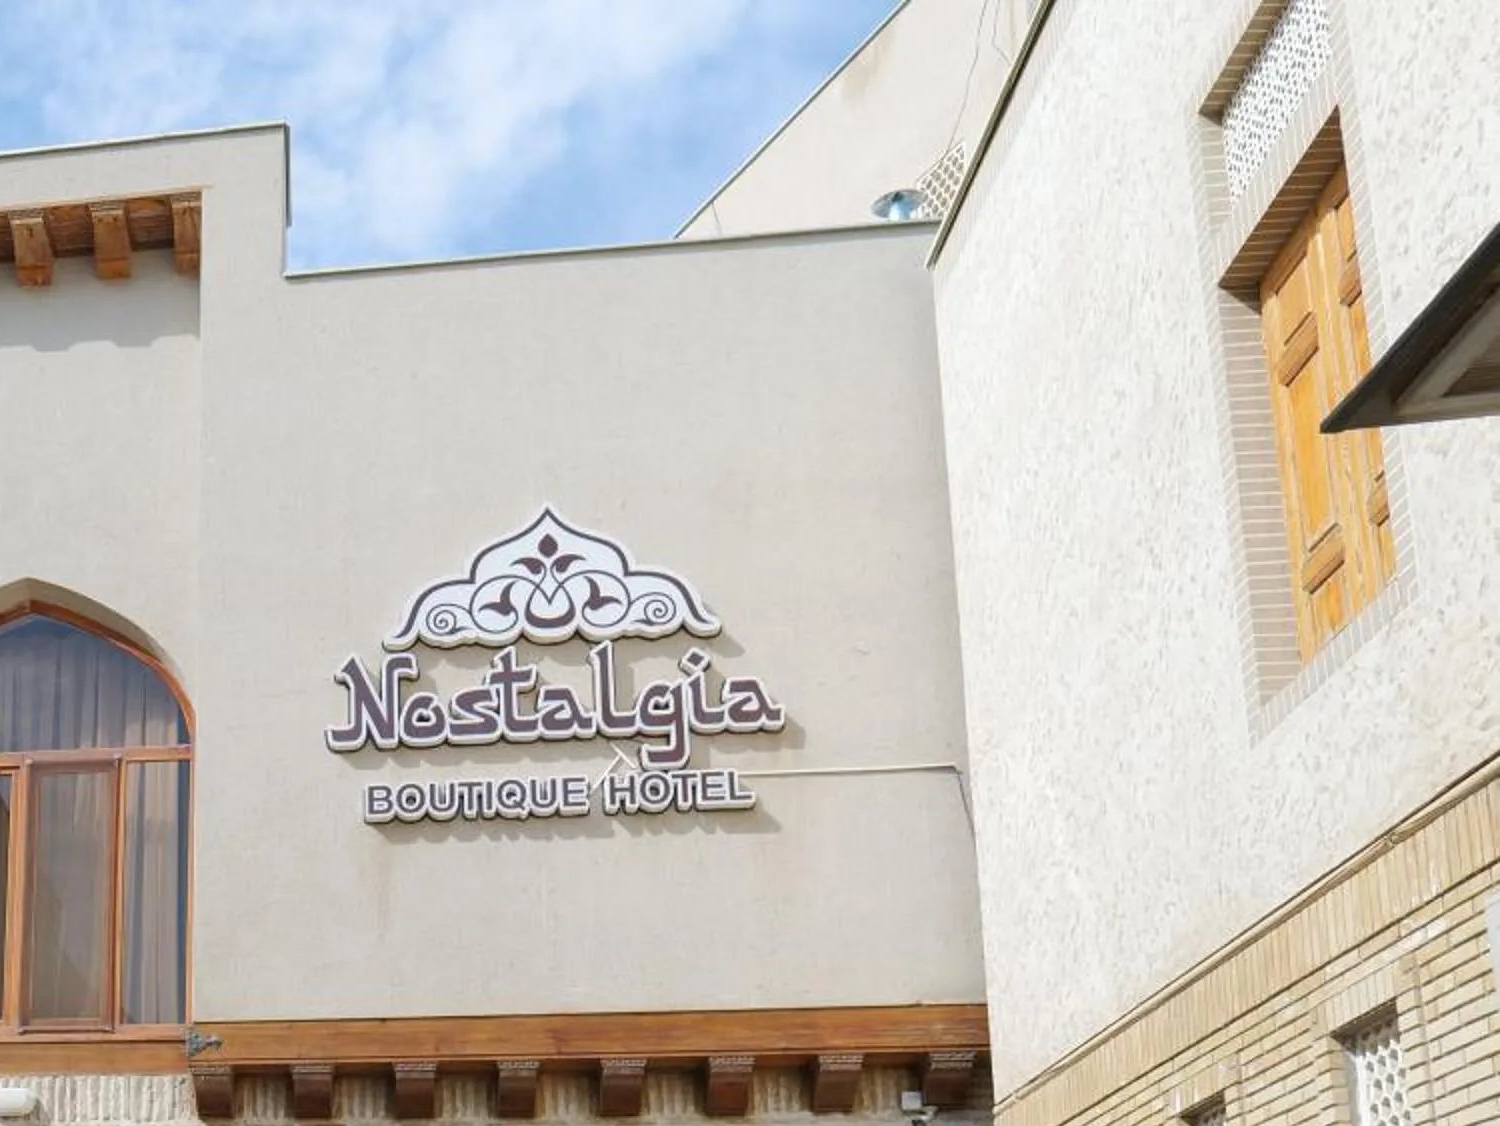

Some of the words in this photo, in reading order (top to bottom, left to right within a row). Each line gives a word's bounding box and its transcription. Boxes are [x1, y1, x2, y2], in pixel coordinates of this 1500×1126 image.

[327, 642, 785, 769] Nostalgia
[366, 777, 591, 819] BOUTIQUE
[606, 770, 754, 810] HOTEL
